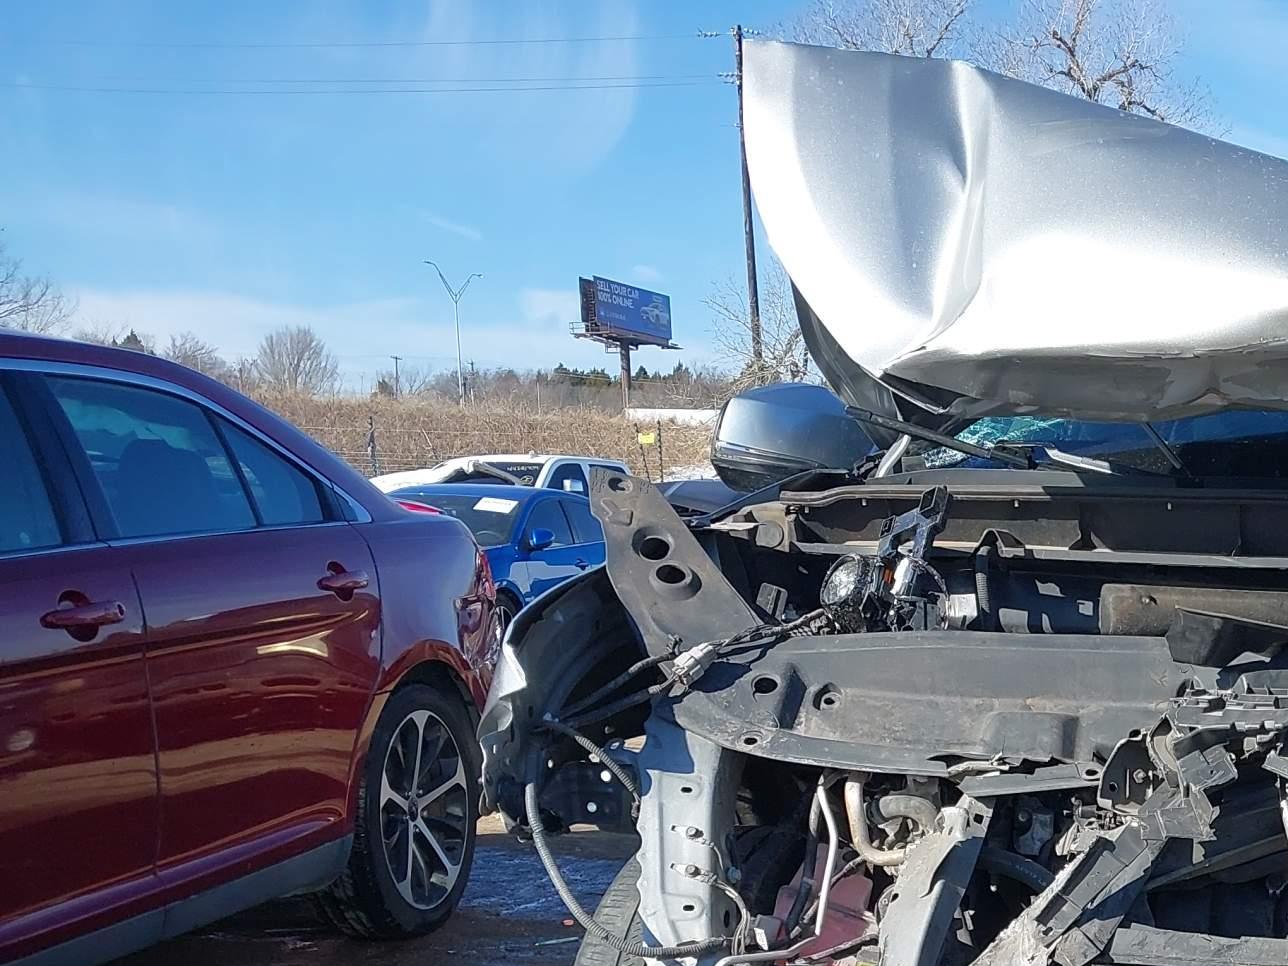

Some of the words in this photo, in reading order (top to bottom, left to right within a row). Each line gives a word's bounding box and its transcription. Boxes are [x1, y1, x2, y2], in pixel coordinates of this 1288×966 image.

[596, 280, 610, 292] SELL
[610, 284, 627, 296] YOUR
[627, 288, 640, 299] CAR
[598, 291, 611, 303] 100%
